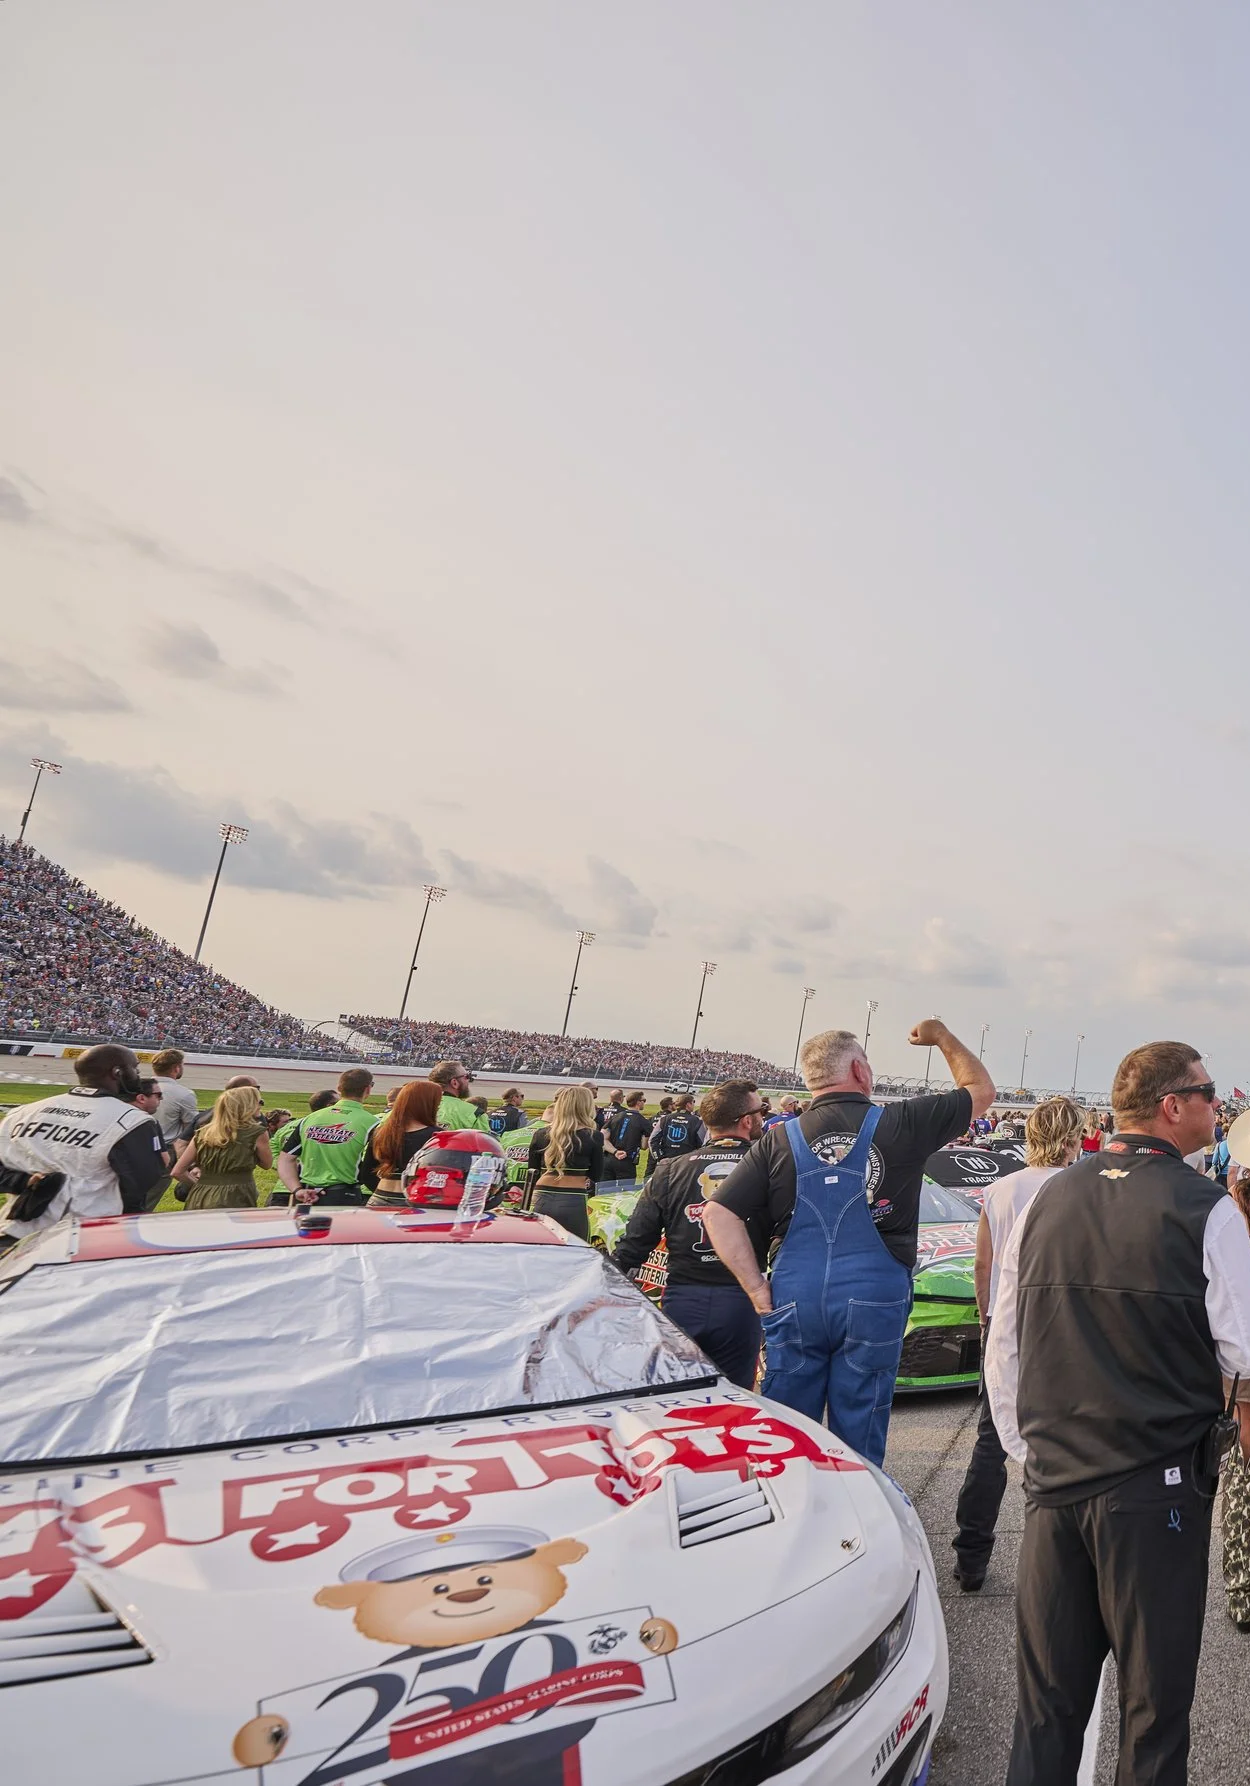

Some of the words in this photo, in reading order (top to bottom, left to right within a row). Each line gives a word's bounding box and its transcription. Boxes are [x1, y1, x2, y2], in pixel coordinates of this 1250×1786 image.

[10, 1121, 101, 1149] OFFICIAL
[55, 1107, 91, 1119] NASCAR
[307, 1126, 356, 1137] INTERSTATE
[230, 1424, 467, 1461] CORPS
[501, 1392, 751, 1427] RESERVE
[238, 1464, 479, 1520] FOR
[296, 1632, 579, 1786] 250
[413, 1717, 473, 1745] UNITED
[474, 1698, 525, 1723] STATES
